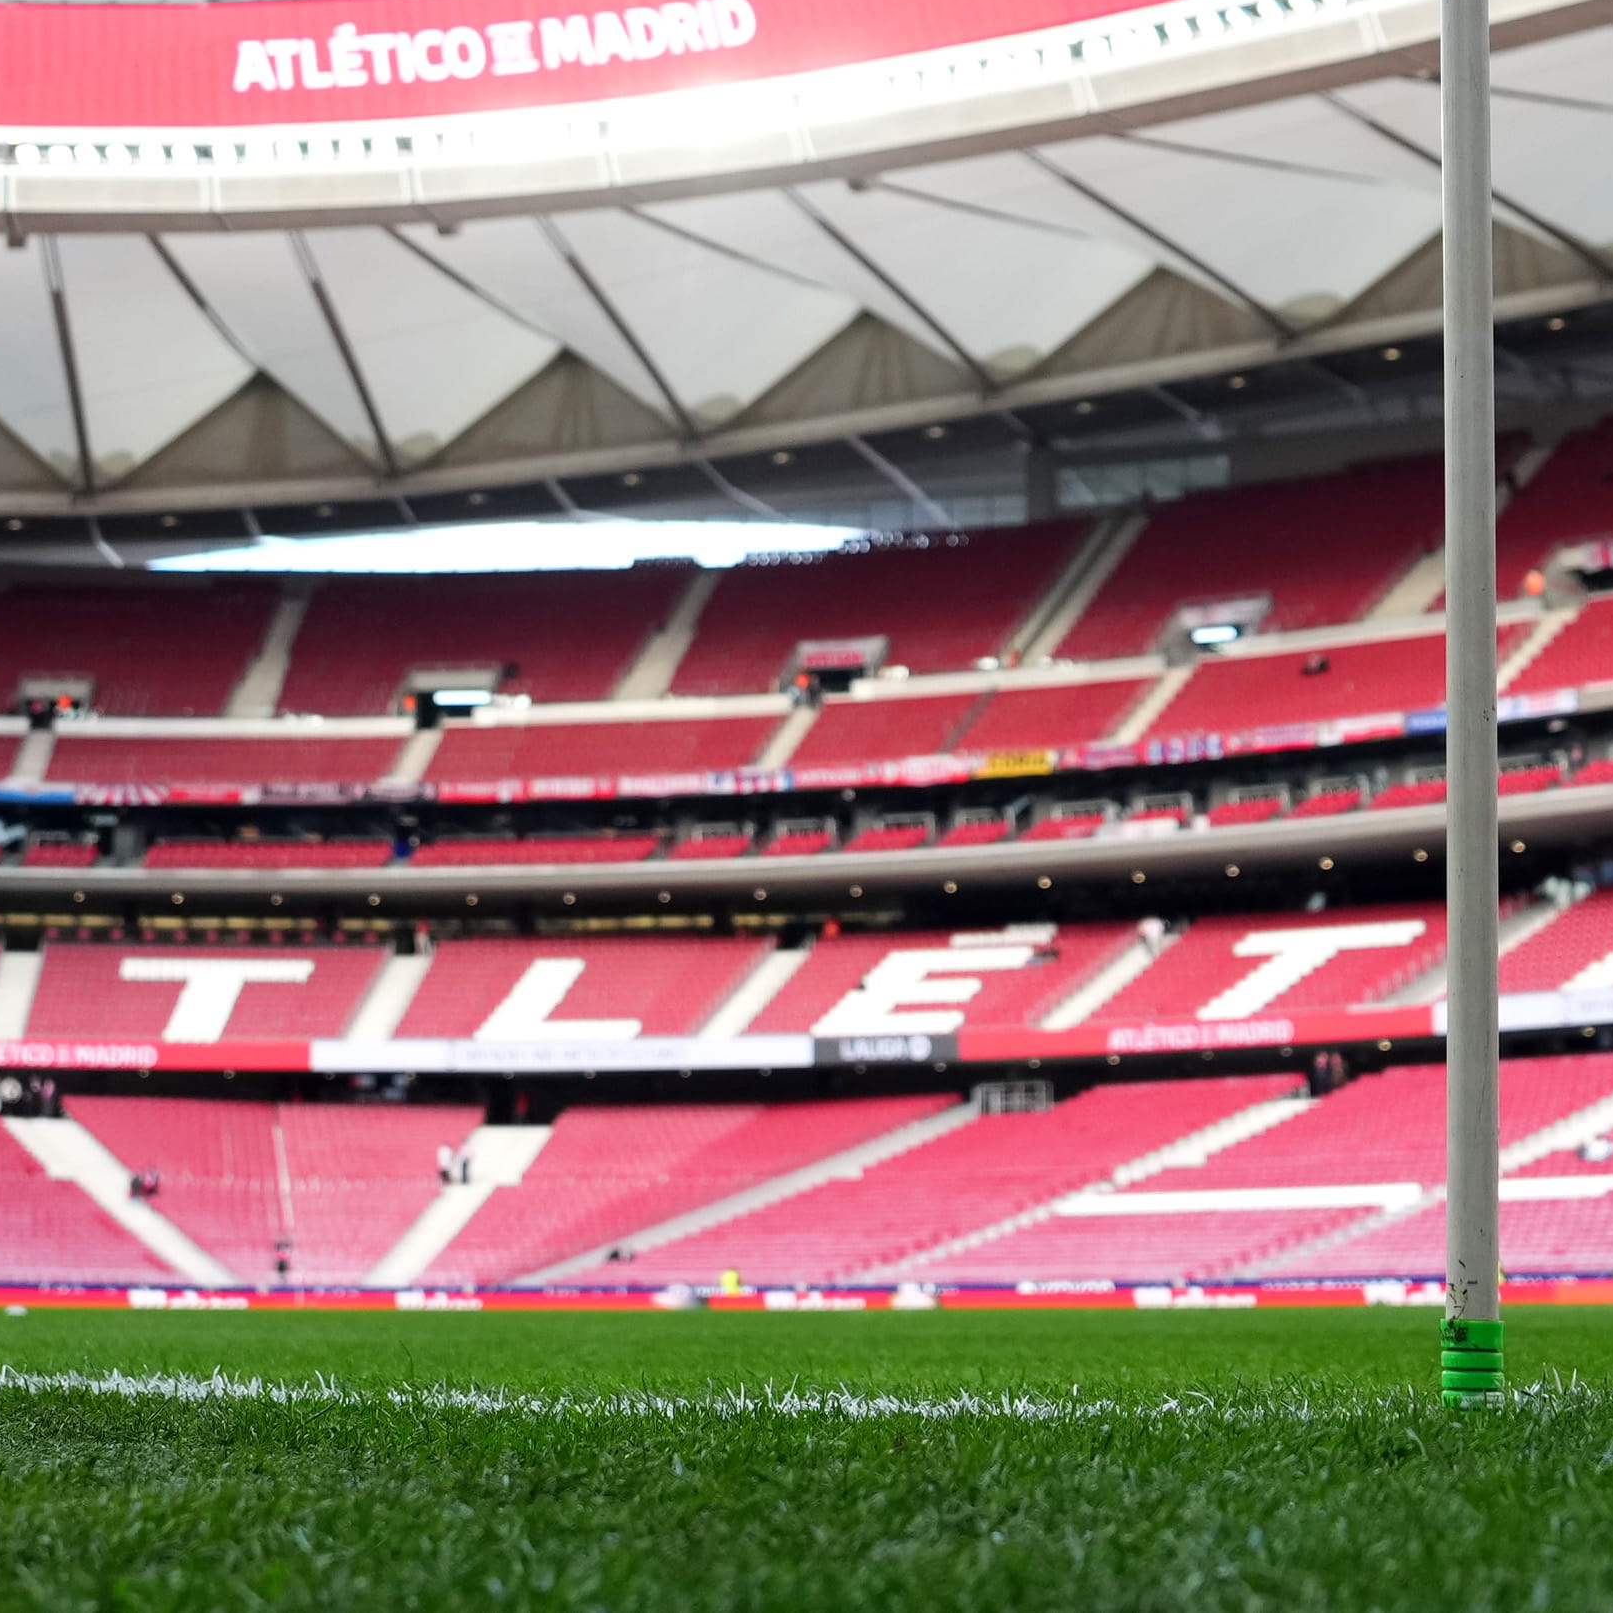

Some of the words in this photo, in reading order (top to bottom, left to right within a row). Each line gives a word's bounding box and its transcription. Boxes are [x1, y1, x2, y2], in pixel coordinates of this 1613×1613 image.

[234, 23, 486, 91] ATLÉTICO
[1215, 1020, 1294, 1046] MADRID
[74, 1044, 158, 1068] MADRID
